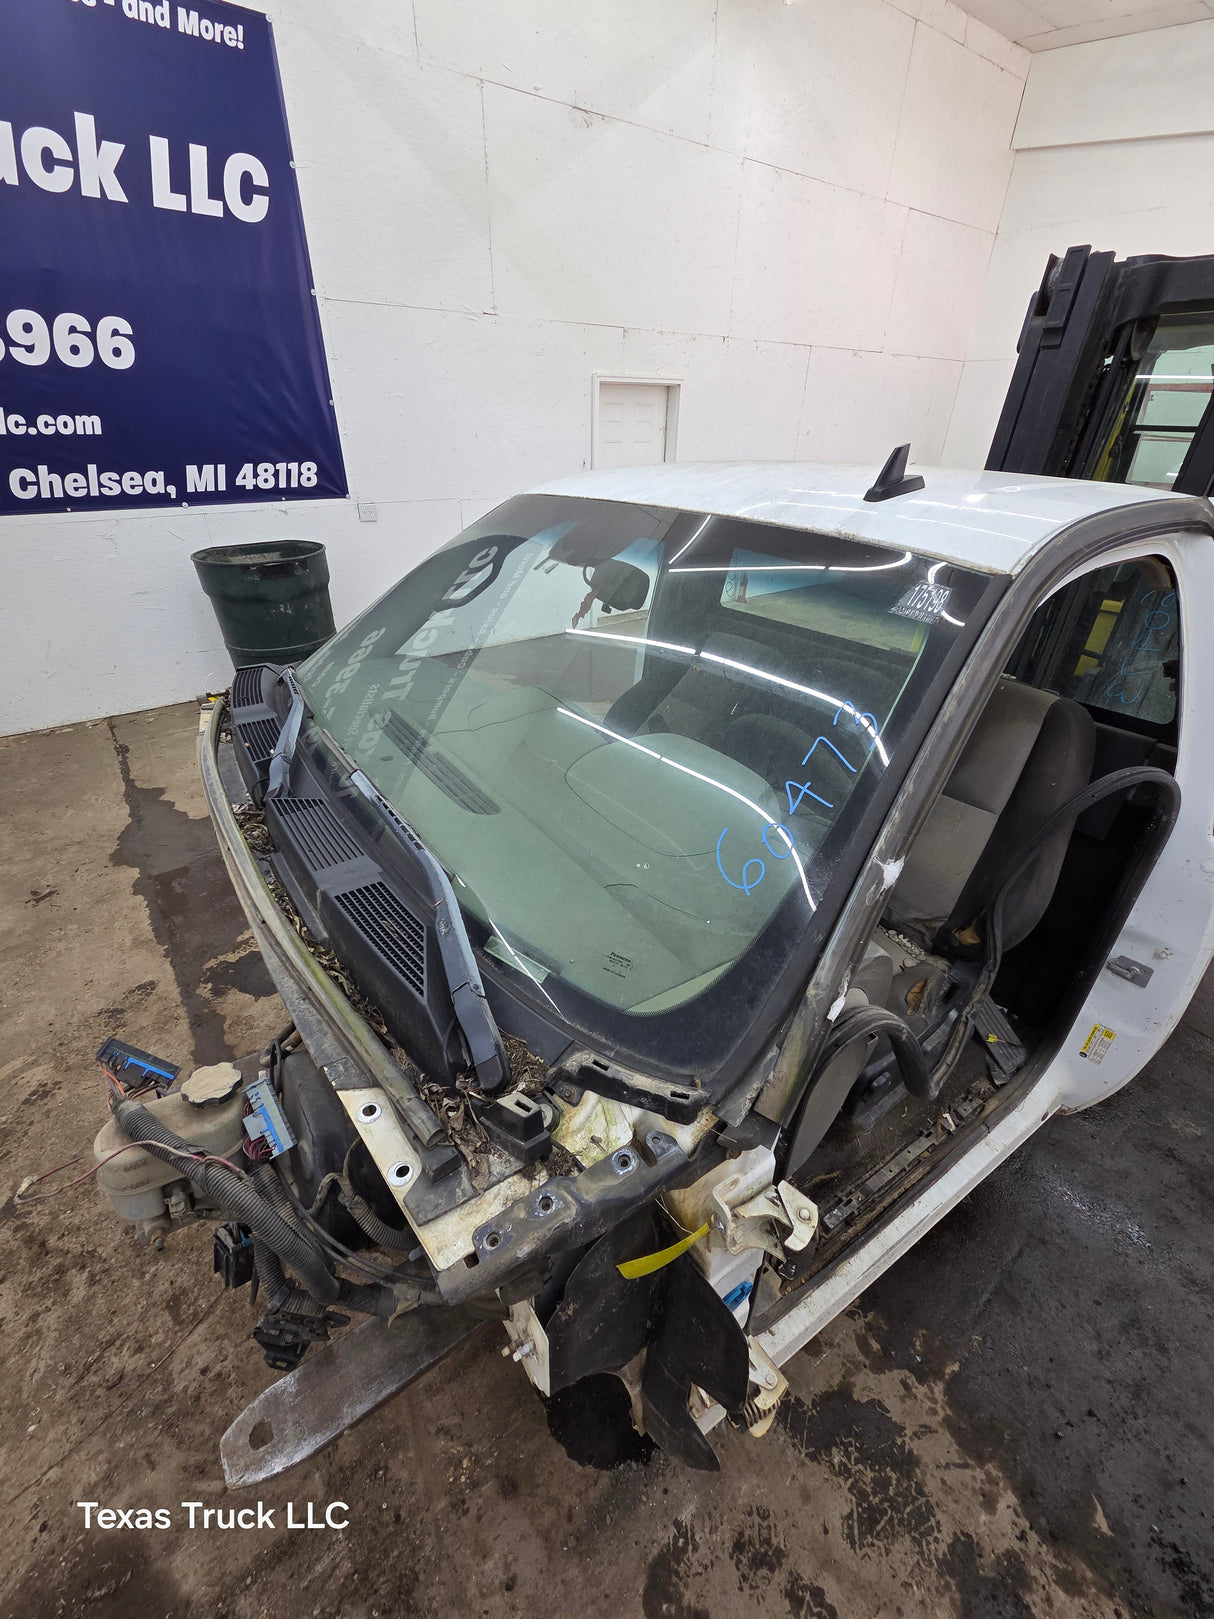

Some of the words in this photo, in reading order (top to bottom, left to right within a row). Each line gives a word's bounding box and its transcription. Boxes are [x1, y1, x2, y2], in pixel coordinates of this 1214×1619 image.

[122, 0, 171, 29] and
[177, 6, 245, 50] More!
[149, 134, 270, 223] LLC
[0, 308, 136, 370] 966
[8, 464, 176, 500] Chelsea,
[185, 464, 226, 492] MI
[235, 461, 318, 490] 48118
